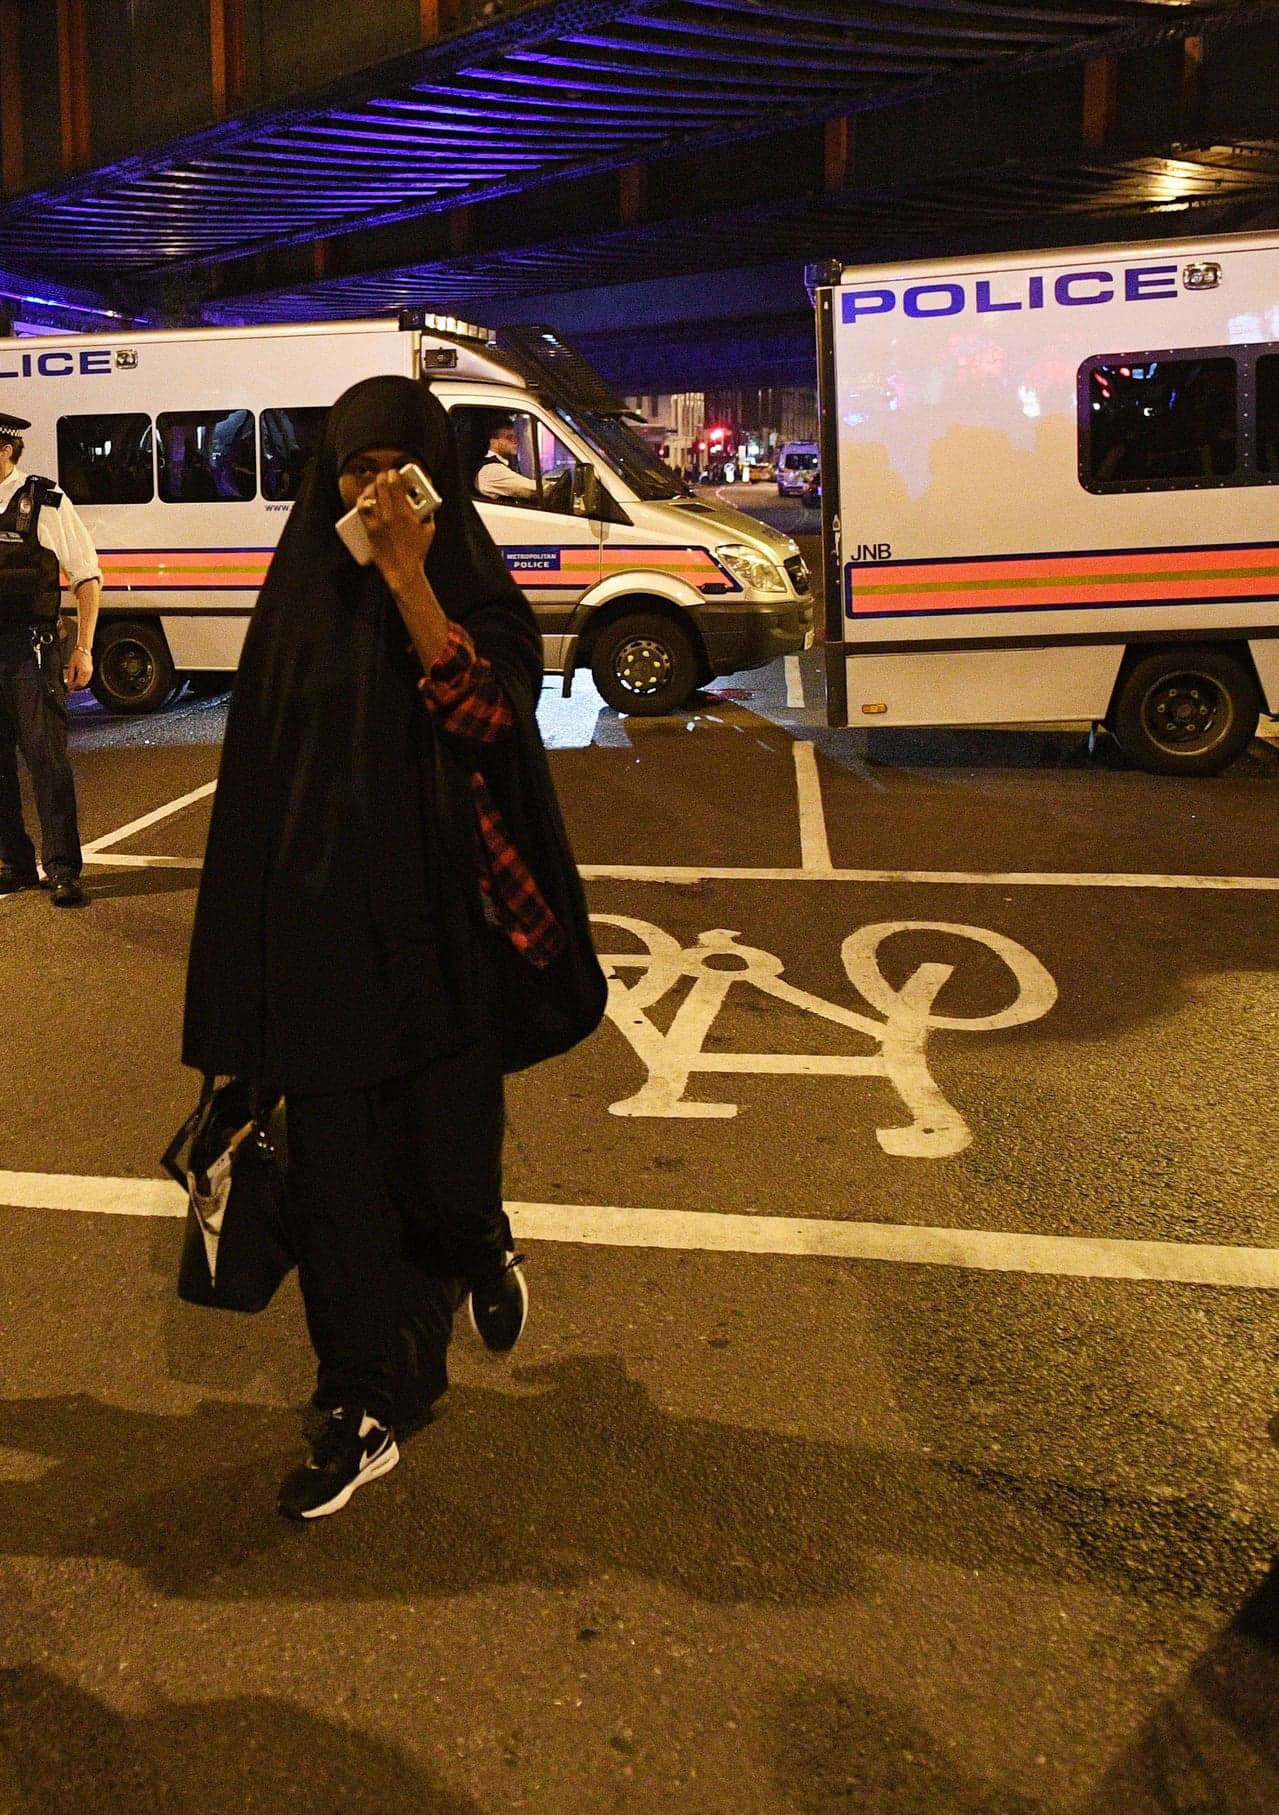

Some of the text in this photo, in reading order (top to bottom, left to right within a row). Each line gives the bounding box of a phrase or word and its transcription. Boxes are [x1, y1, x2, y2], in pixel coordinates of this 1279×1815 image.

[842, 265, 1177, 323] POLICE
[850, 543, 892, 561] JNB
[513, 561, 550, 569] POLICE
